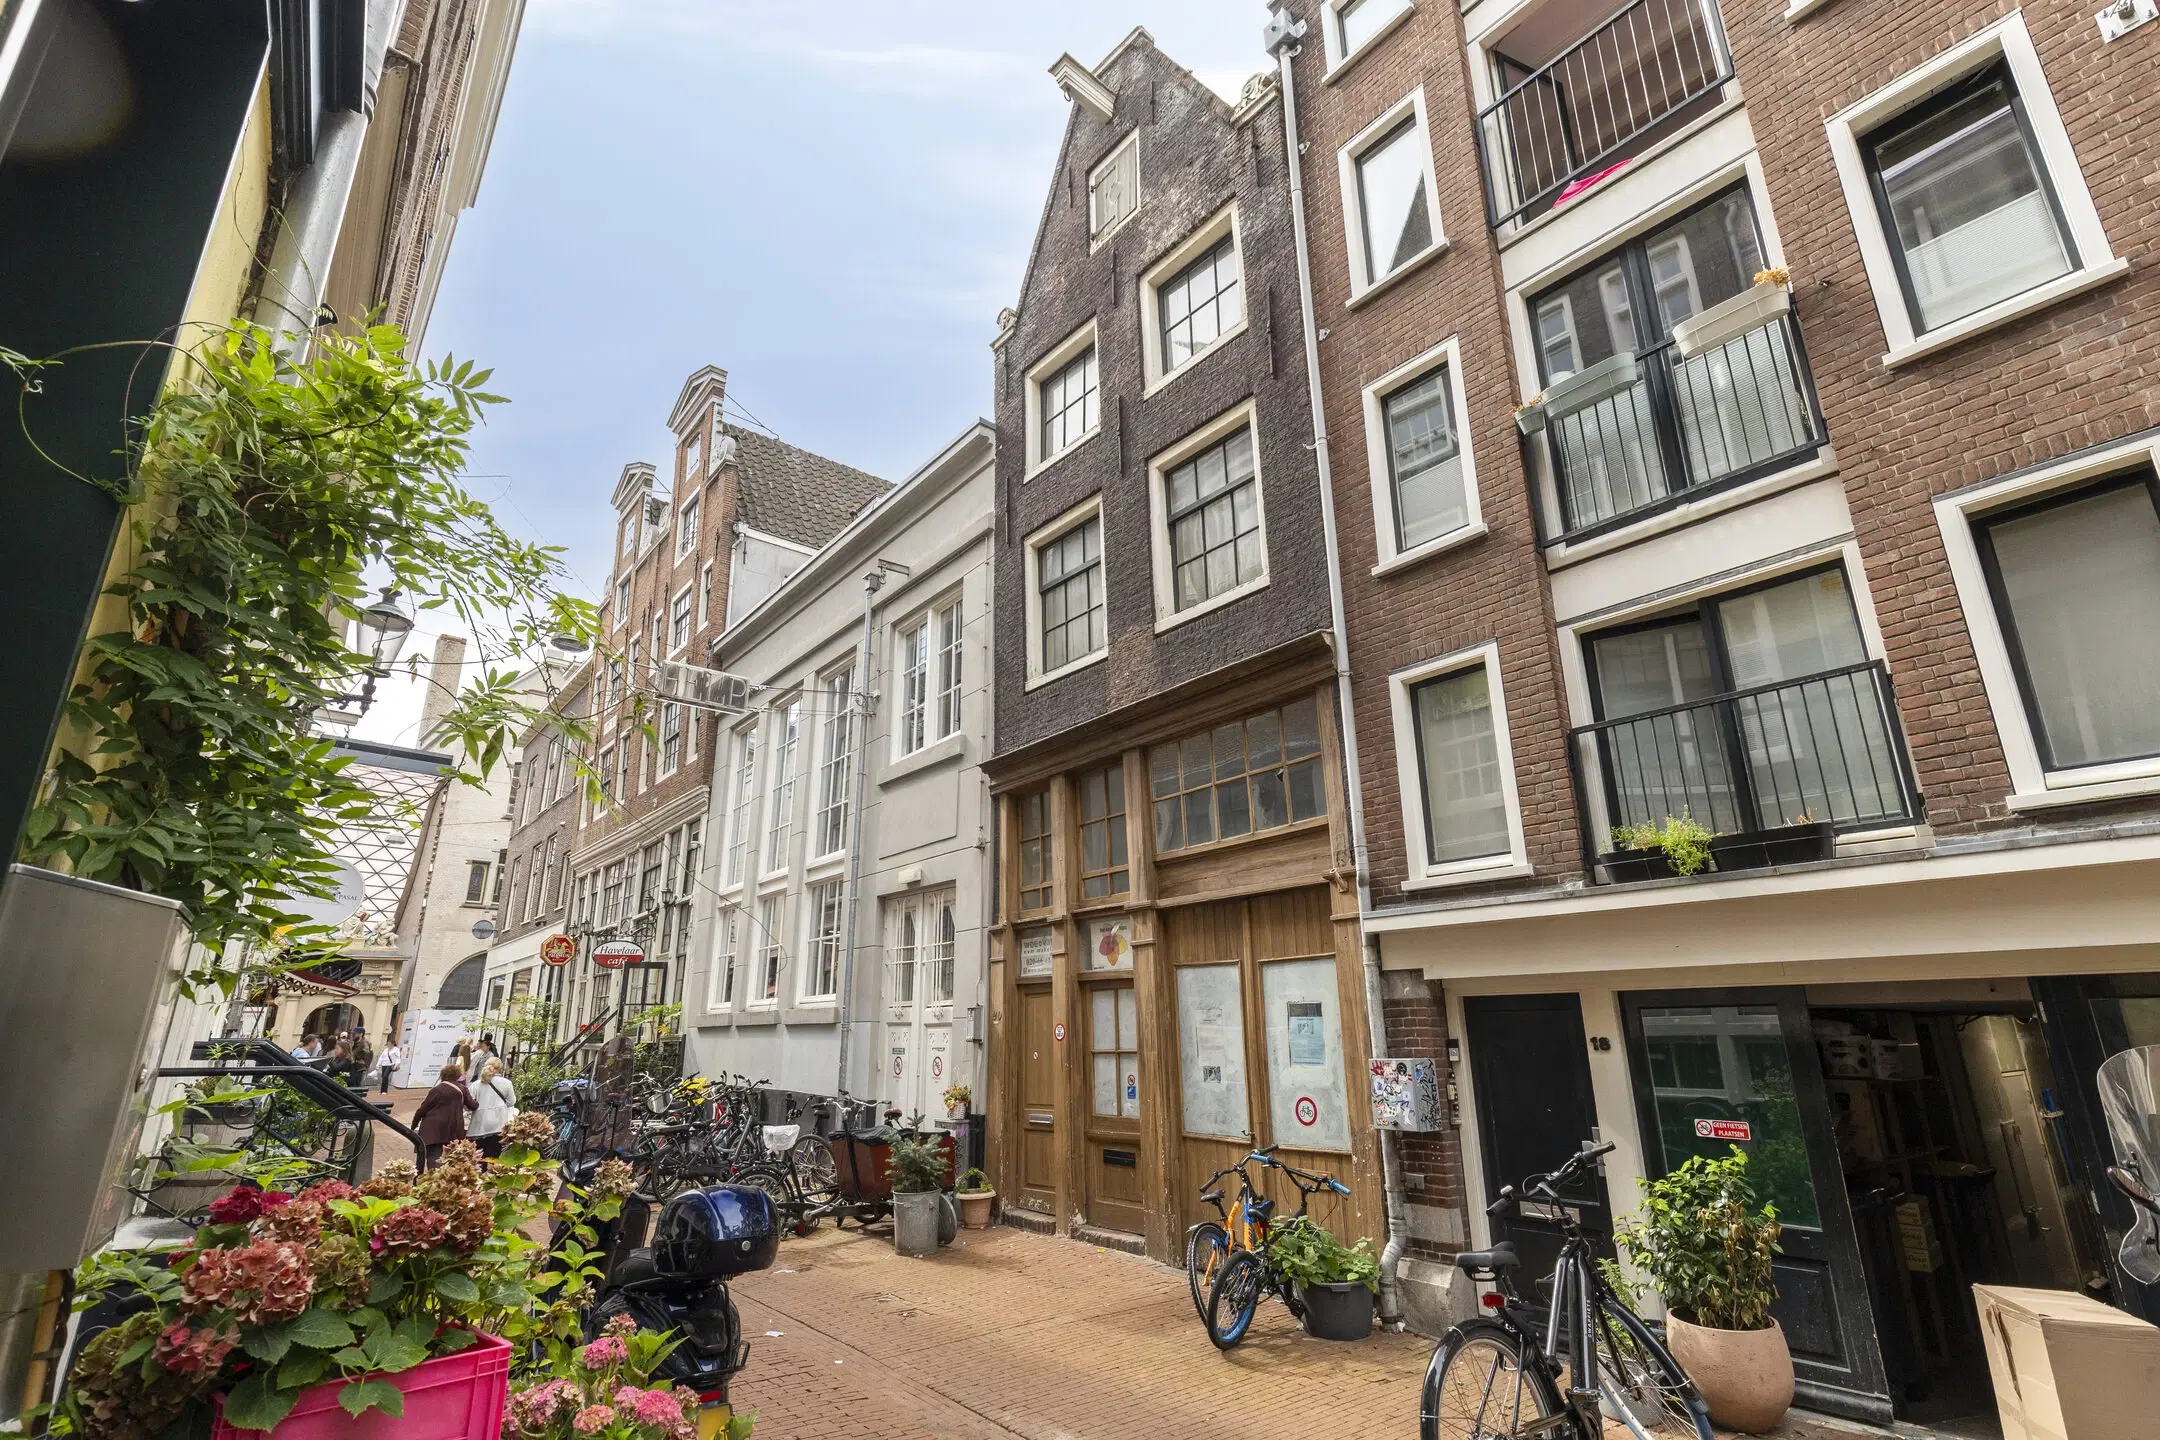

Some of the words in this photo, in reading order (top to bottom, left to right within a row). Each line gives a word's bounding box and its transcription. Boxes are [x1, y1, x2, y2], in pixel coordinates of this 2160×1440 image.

[600, 946, 640, 955] Havelaar
[1589, 1036, 1612, 1051] 18
[1713, 1121, 1727, 1129] GEEN
[1726, 1122, 1748, 1130] FIETSEN
[1718, 1129, 1745, 1137] PLAATSEN
